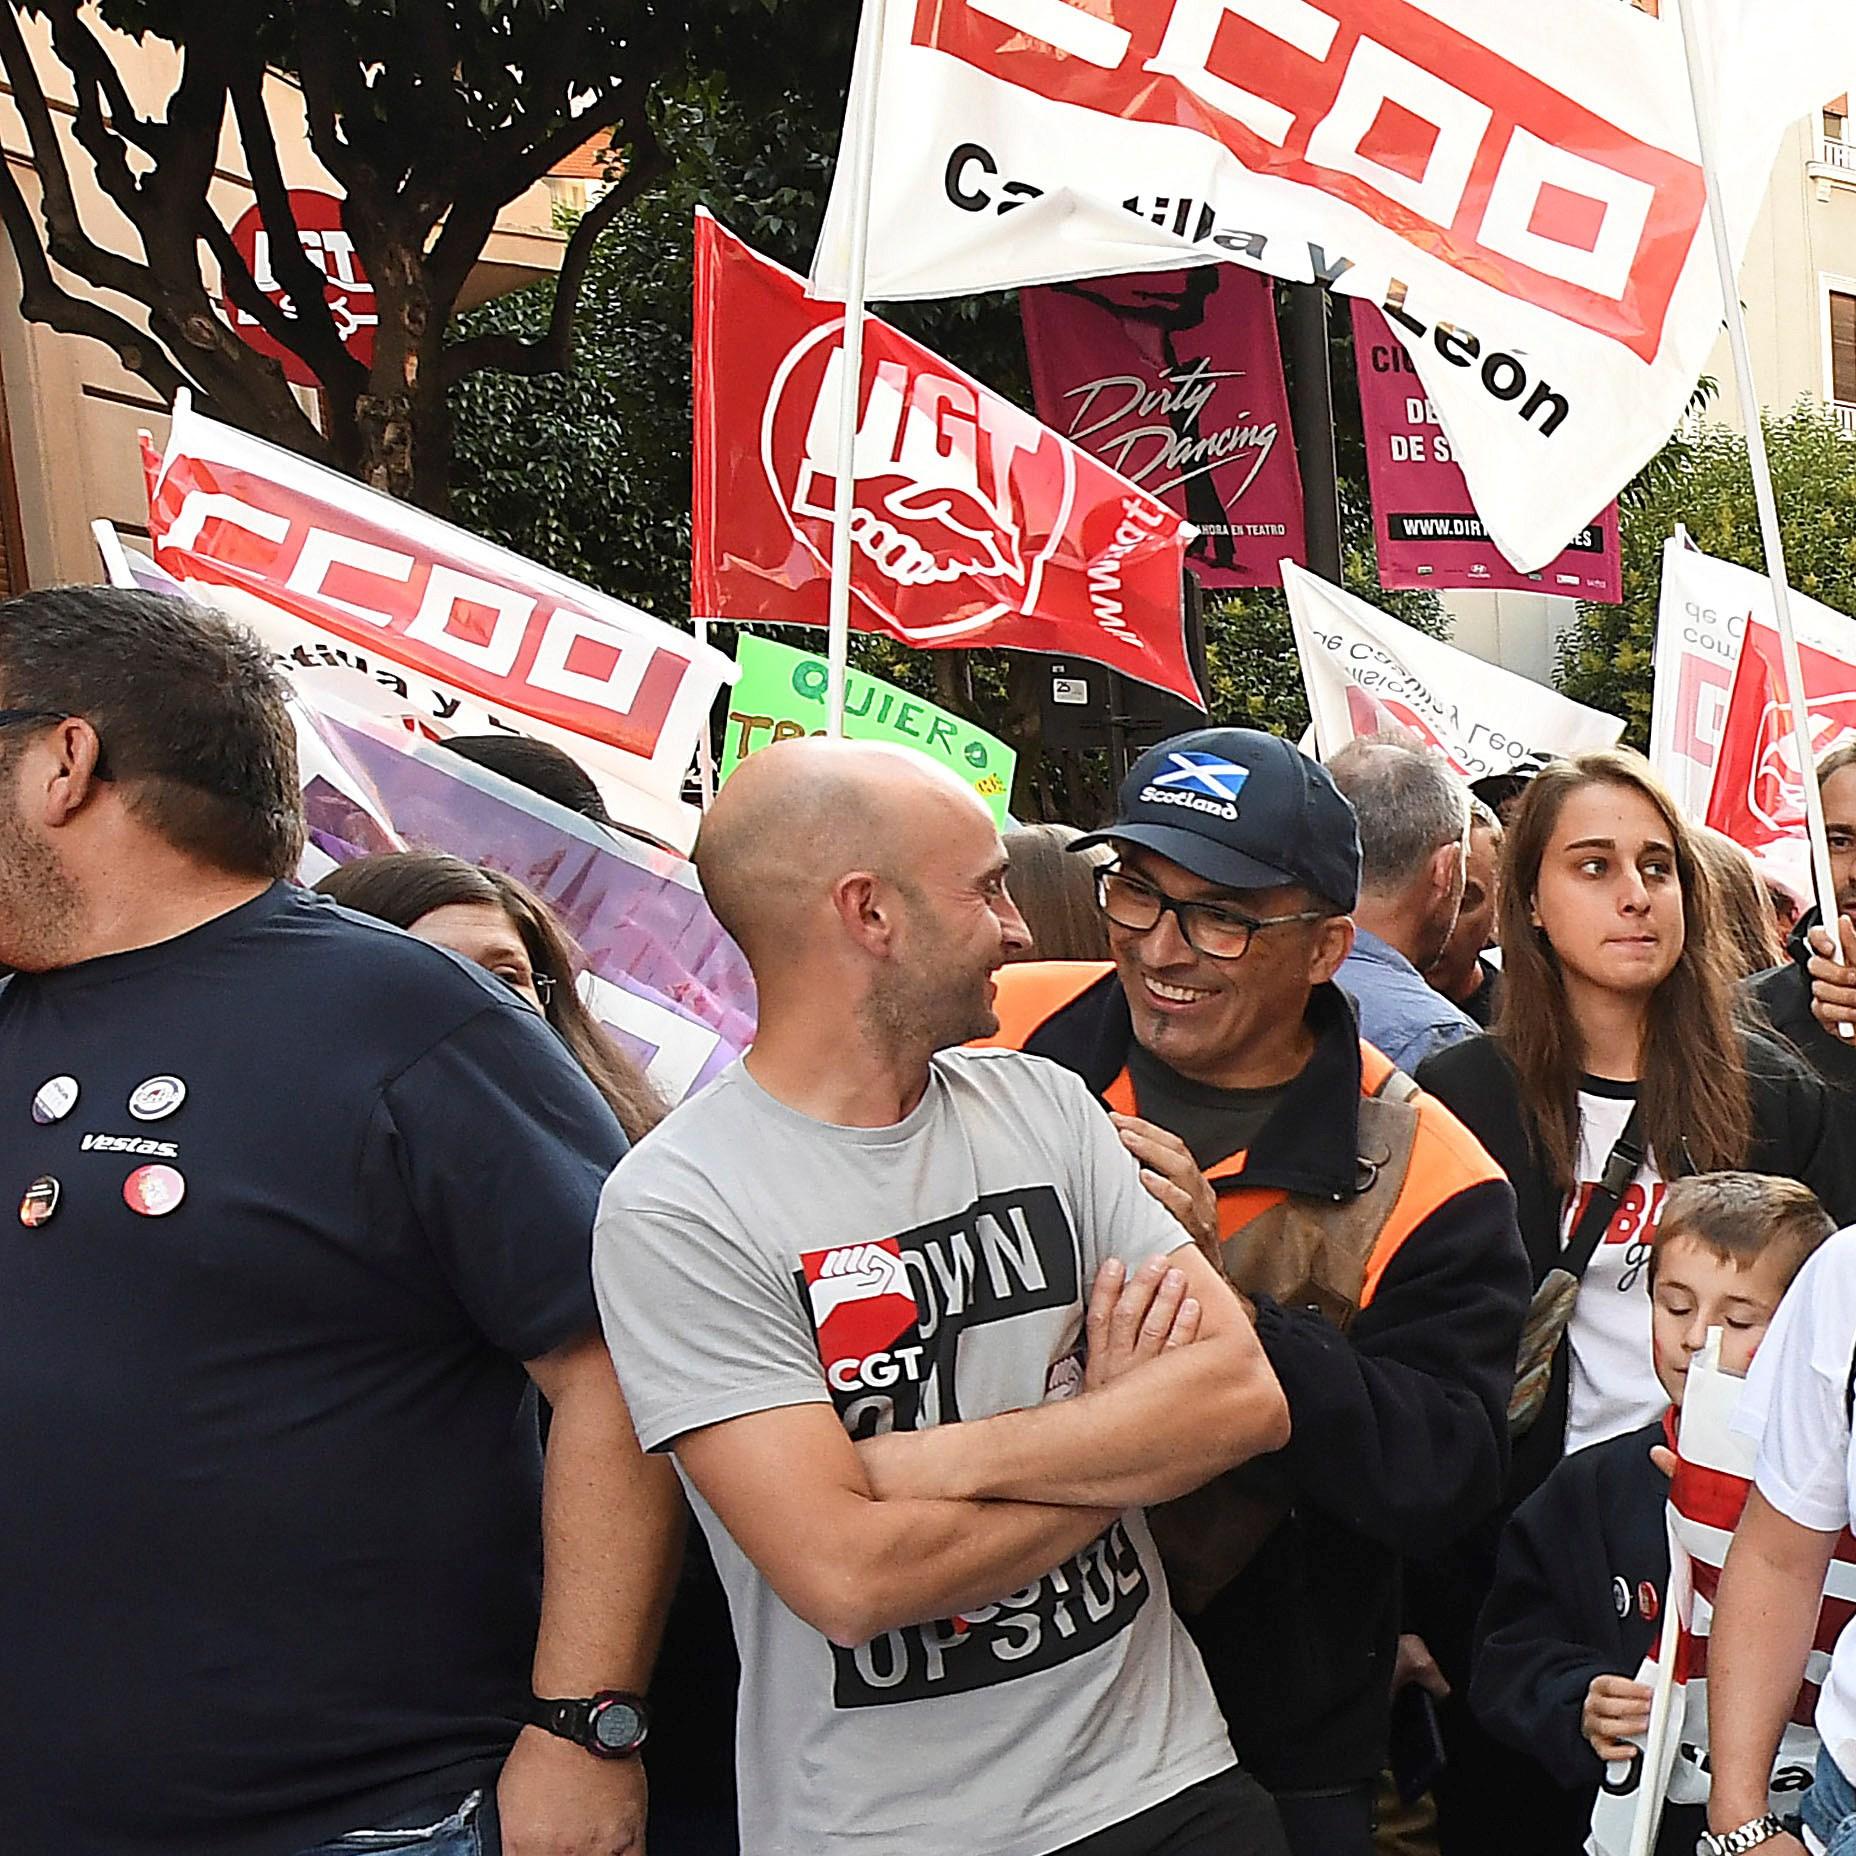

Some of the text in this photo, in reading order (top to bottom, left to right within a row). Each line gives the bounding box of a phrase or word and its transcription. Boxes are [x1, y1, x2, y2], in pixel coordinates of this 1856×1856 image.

[1064, 357, 1246, 438] Dirty
[1386, 277, 1570, 438] León
[1097, 410, 1278, 508] Dancing
[1391, 435, 1425, 462] DE
[791, 659, 989, 769] QUIERO
[1140, 786, 1239, 820] Scotland
[826, 1346, 924, 1391] CGT
